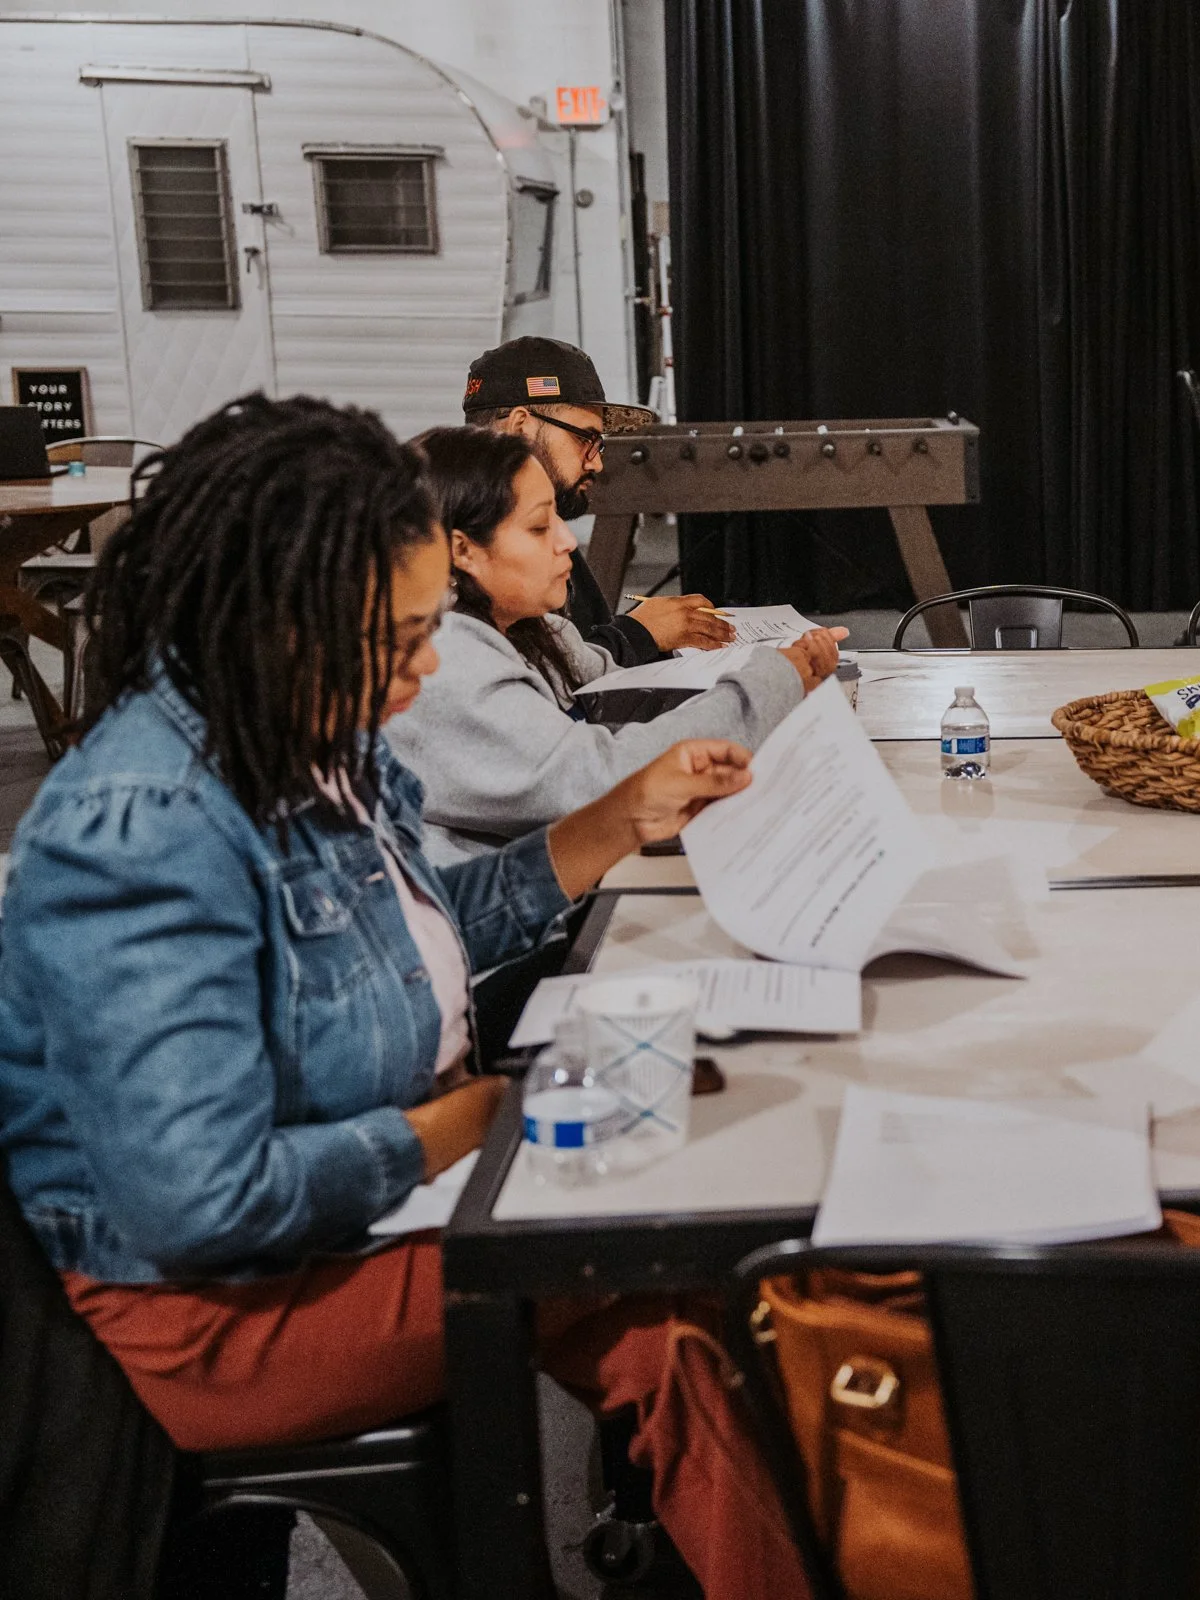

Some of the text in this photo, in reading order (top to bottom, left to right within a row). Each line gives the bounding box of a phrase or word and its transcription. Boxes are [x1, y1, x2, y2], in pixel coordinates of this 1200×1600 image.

[556, 88, 601, 121] EXIT
[29, 384, 68, 394] YOUR
[41, 419, 81, 429] TTERS
